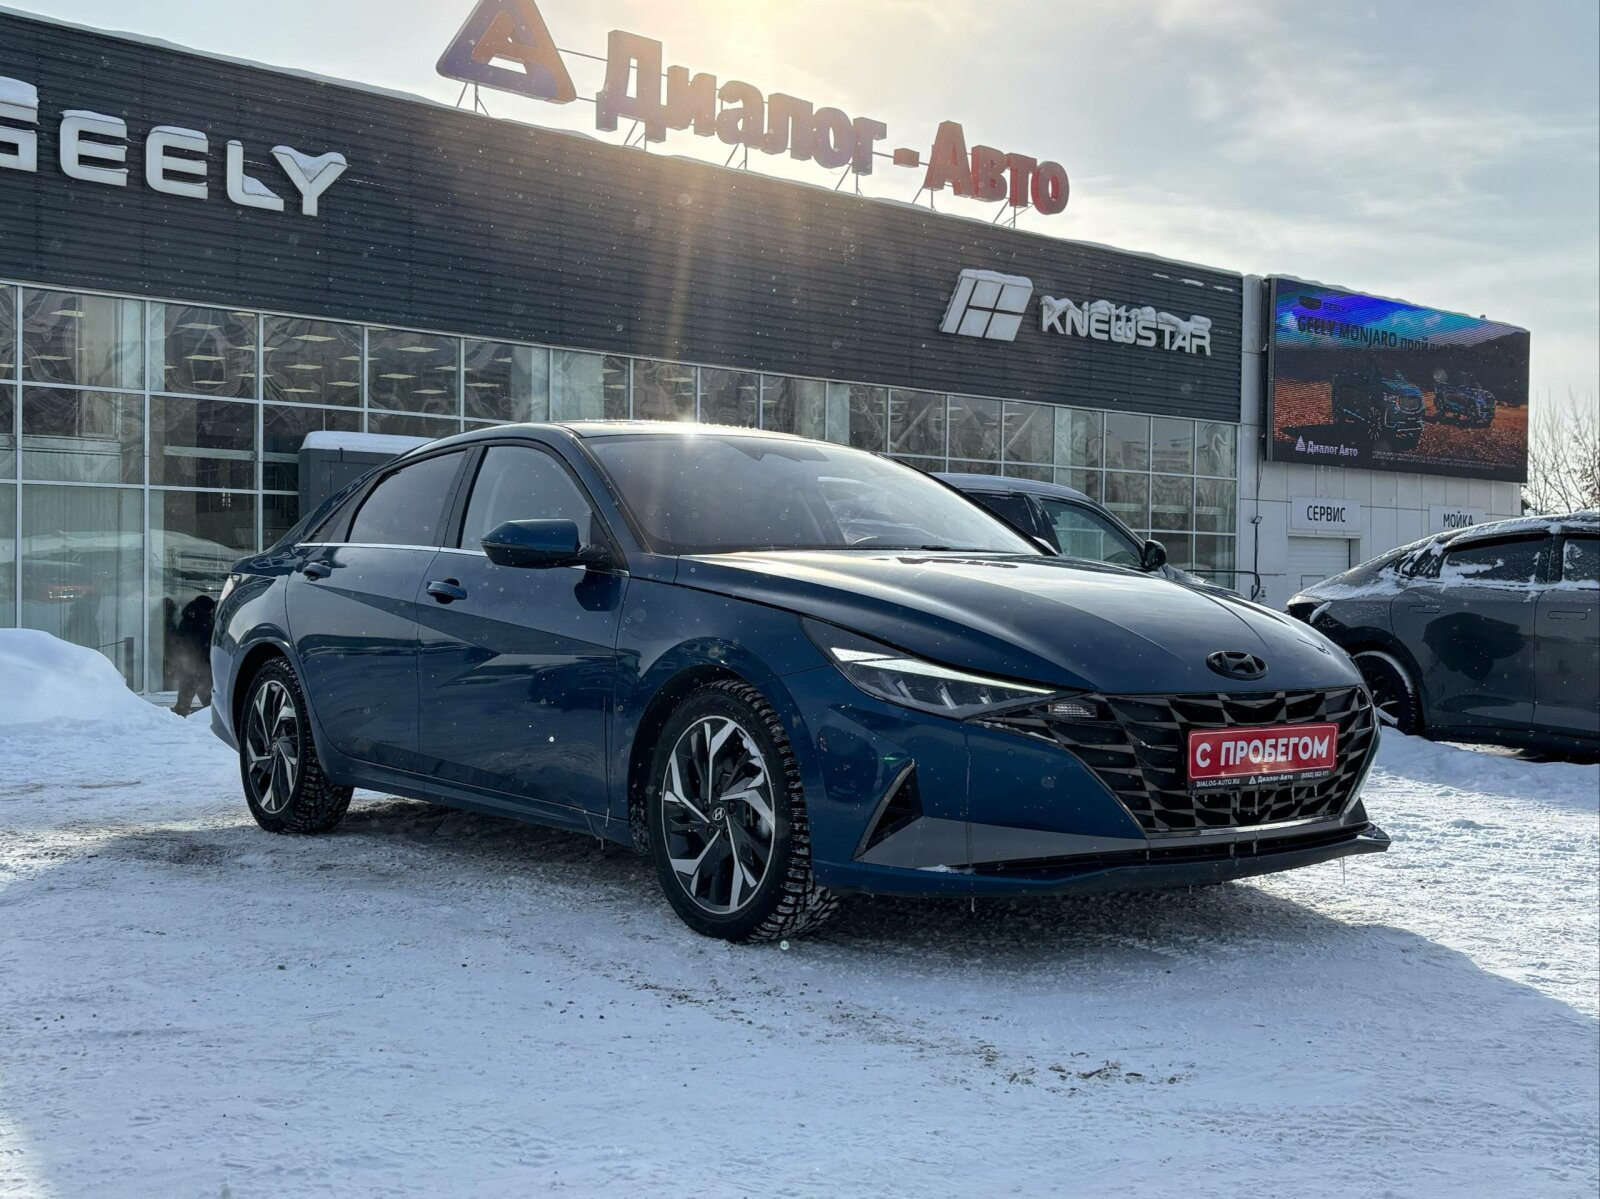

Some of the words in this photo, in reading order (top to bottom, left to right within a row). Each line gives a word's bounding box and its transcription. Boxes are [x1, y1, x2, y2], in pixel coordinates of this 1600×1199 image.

[1041, 297, 1212, 356] KNEWSTAR
[1298, 315, 1334, 336] GEELY
[1339, 324, 1397, 348] MONJARO
[1306, 440, 1339, 455] Диалог
[1339, 443, 1358, 457] Авто
[1306, 505, 1346, 523] СЕРВИС
[1442, 512, 1474, 528] МОЙКА
[1196, 742, 1212, 768] С
[1220, 735, 1330, 766] ПРОБЕГОМ
[1196, 778, 1240, 788] DIALOG-AUTO.RU
[1257, 774, 1294, 784] Диалог-Авто
